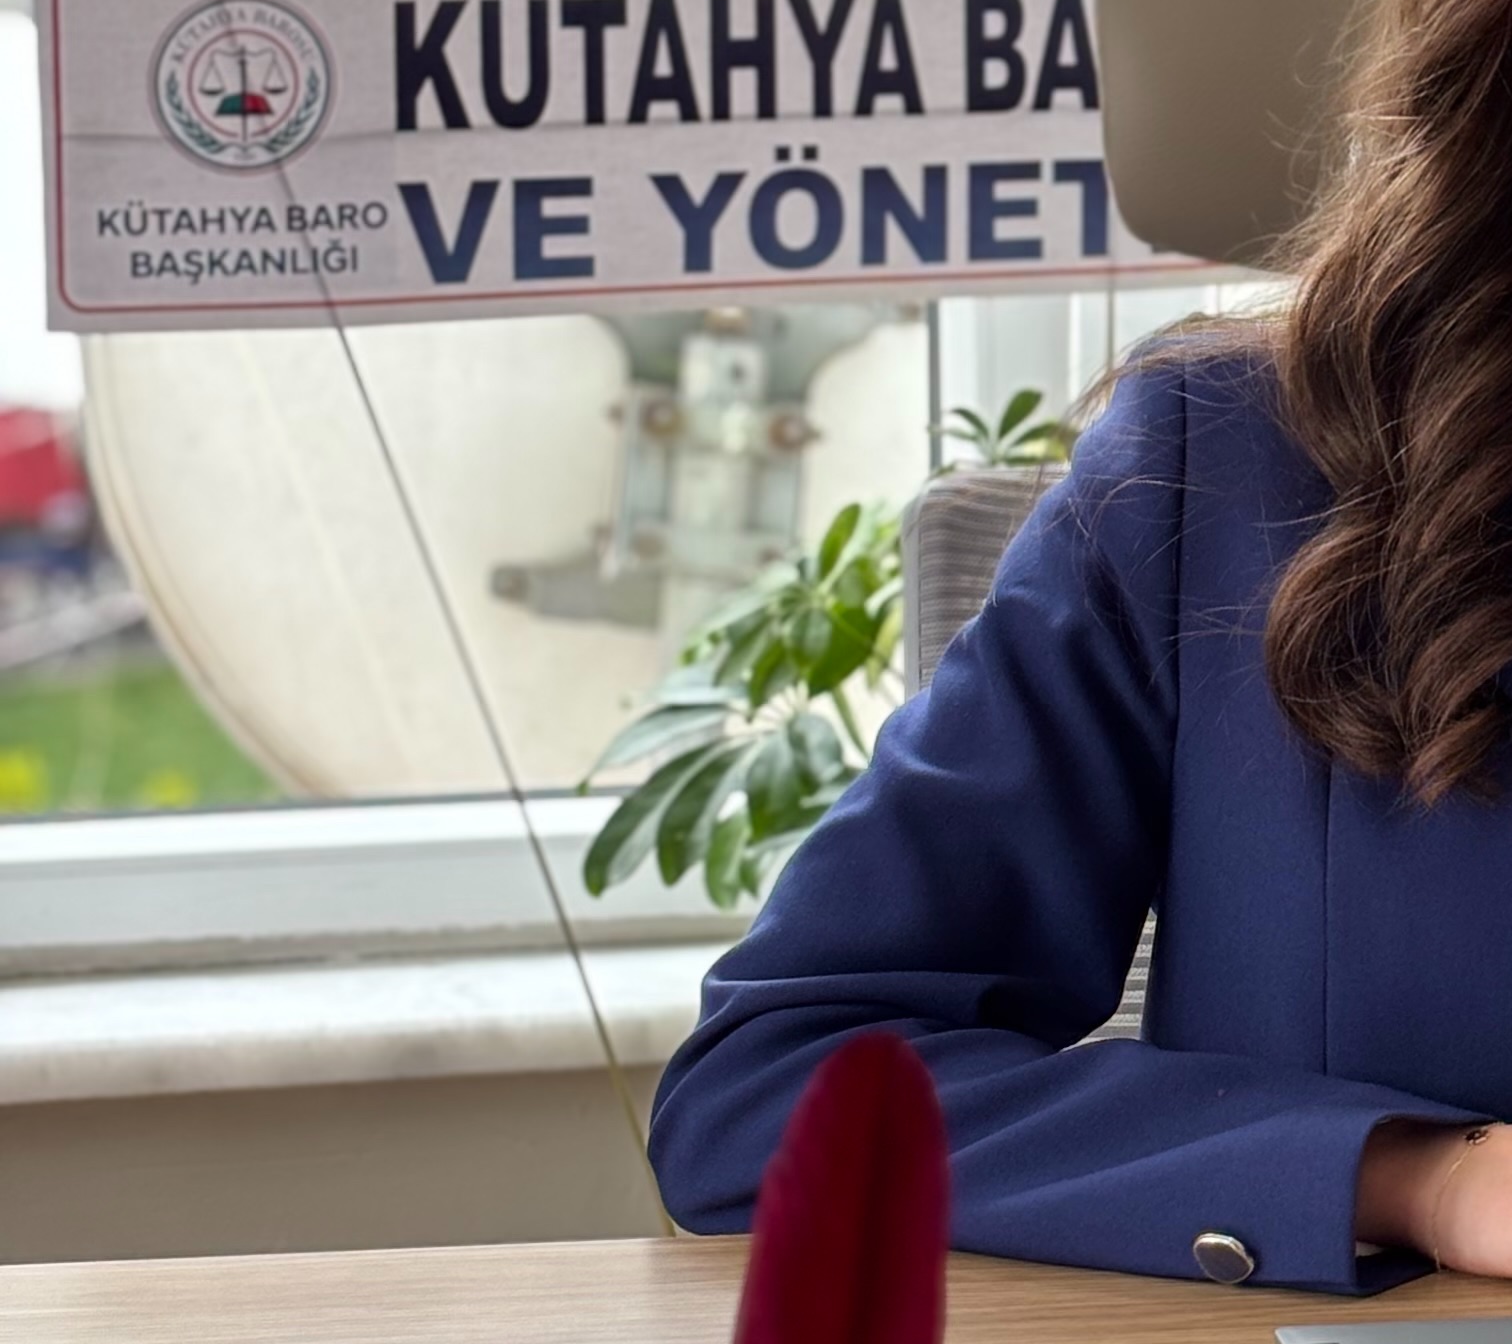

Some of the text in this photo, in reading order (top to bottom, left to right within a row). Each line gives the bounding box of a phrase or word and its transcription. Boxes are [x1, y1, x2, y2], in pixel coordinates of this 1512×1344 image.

[98, 200, 388, 238] KÜTAHYA BARO
[396, 145, 1182, 284] VE YÖNET
[130, 238, 359, 286] BAŞKANLIĞI
